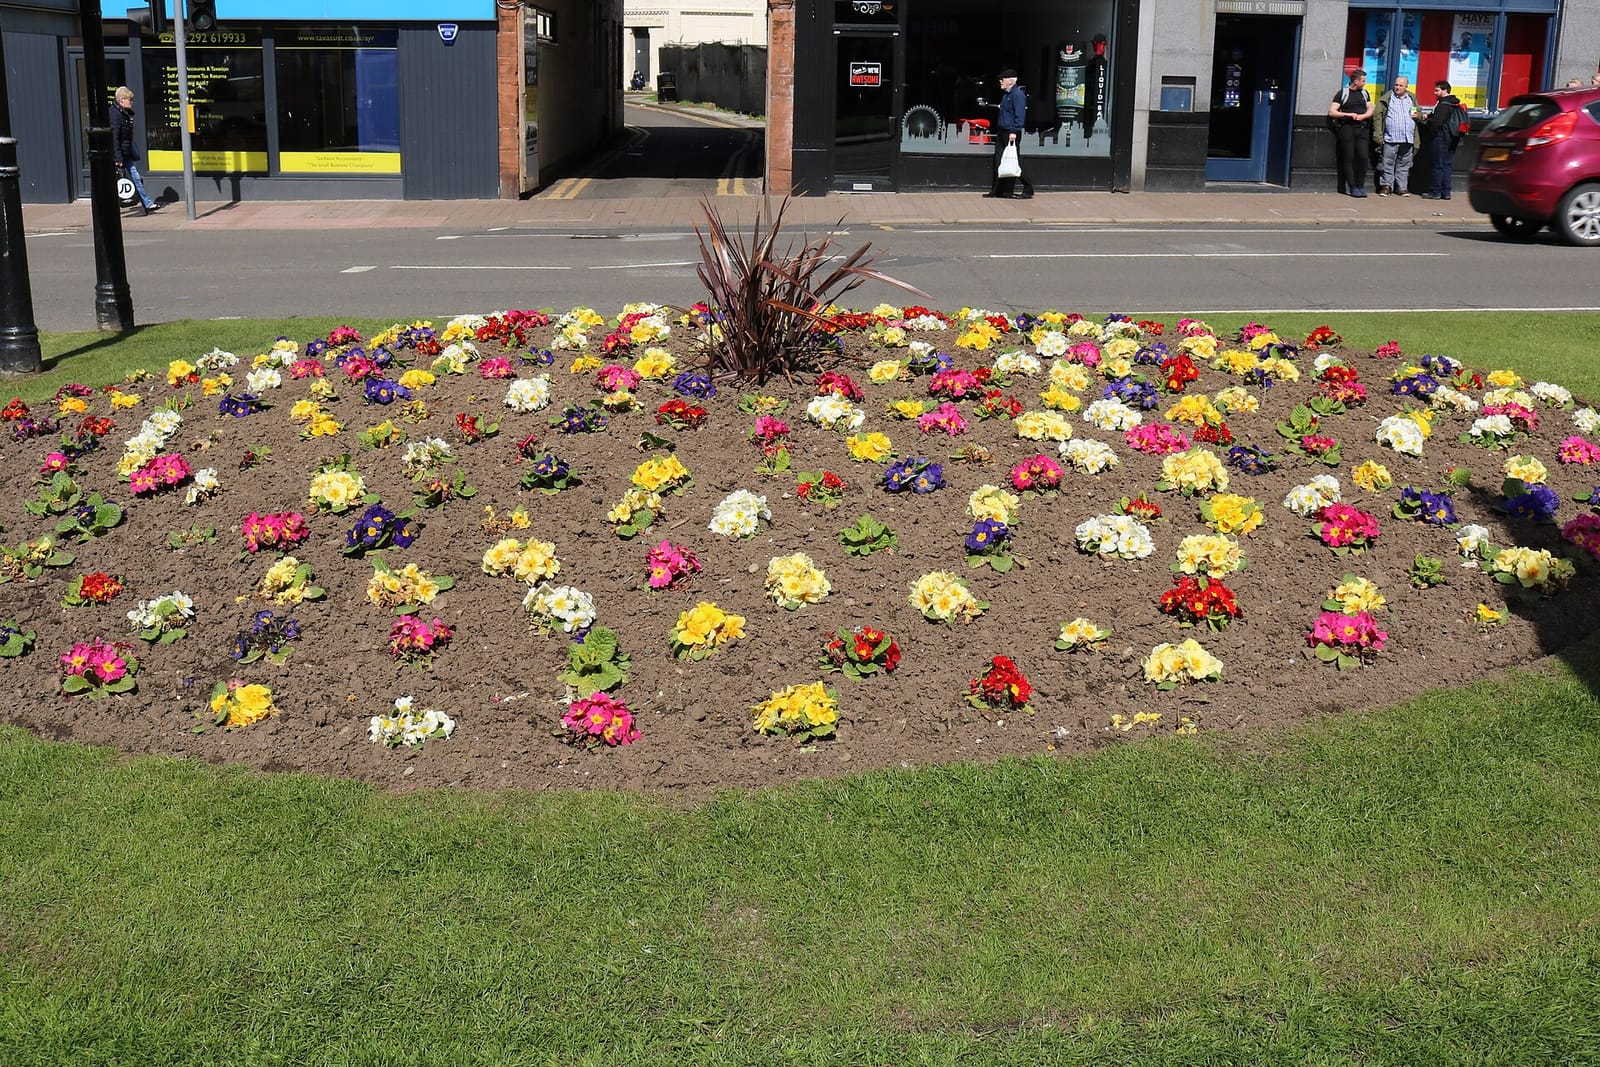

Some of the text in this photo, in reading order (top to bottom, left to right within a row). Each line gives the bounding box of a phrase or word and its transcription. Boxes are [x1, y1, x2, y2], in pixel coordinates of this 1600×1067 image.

[1462, 14, 1491, 23] HAYE
[189, 32, 246, 43] 292 619933
[852, 75, 879, 84] AWESOME
[119, 183, 132, 194] JD
